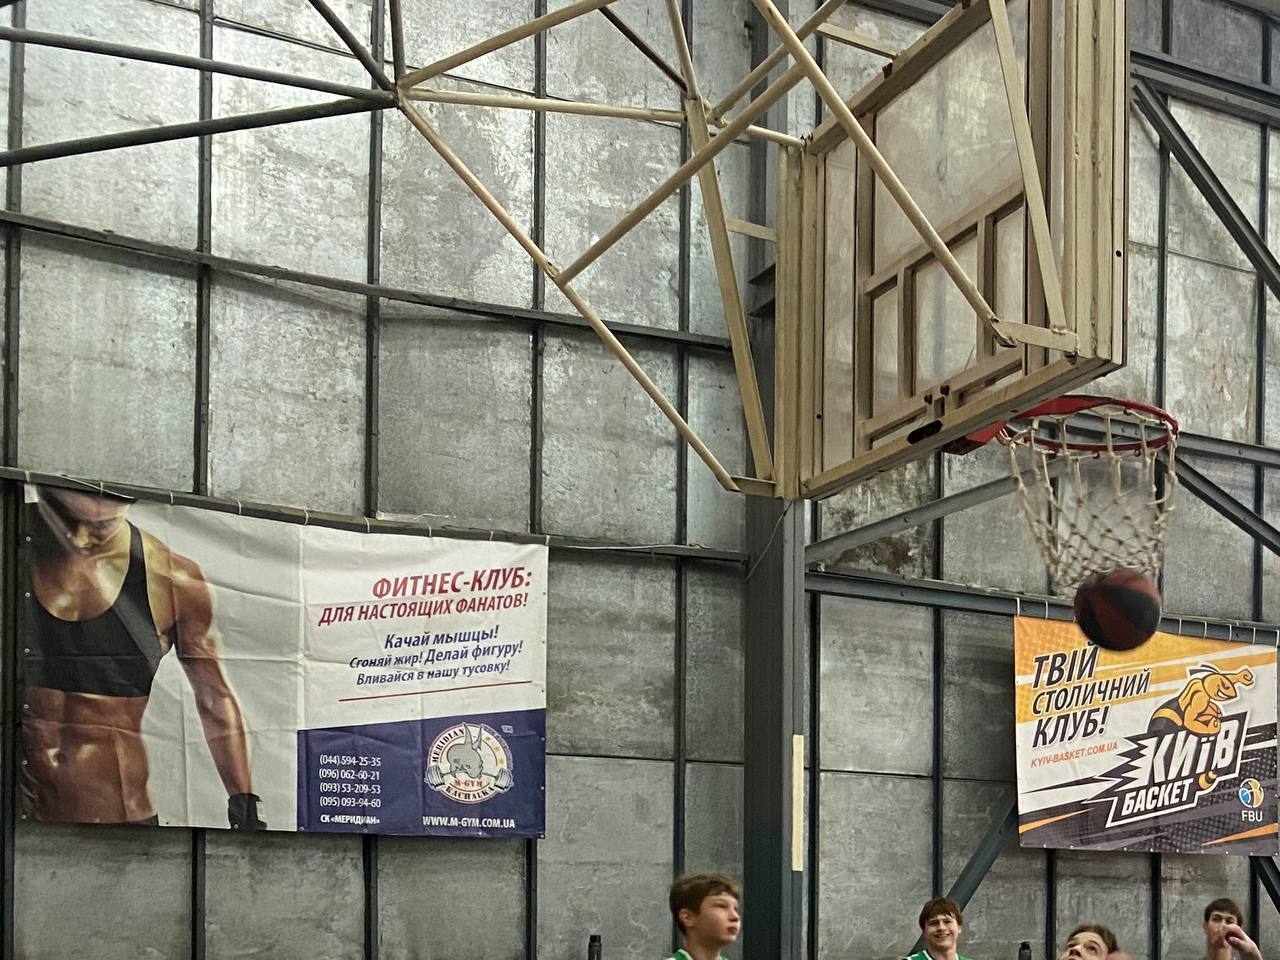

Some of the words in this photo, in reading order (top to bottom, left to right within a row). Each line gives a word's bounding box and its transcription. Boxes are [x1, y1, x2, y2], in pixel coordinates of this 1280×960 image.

[372, 567, 532, 599] ФИТНЕС-КЛУБ:
[318, 606, 355, 626] ДЛЯ
[358, 600, 454, 620] НАСТОЯЩИХ
[456, 593, 529, 614] ФАНАТОВ!
[384, 631, 431, 649] Качай
[433, 625, 500, 645] мышцы!
[349, 655, 392, 668] Сгоняй
[394, 652, 423, 667] жир!
[424, 646, 468, 665] Делай
[472, 640, 523, 660] фигуру!
[1032, 641, 1099, 688] ТВІЙ
[357, 671, 414, 685] Вливайся
[417, 671, 424, 680] в
[427, 667, 459, 679] нашу
[463, 660, 511, 677] тусовку!
[1032, 667, 1151, 714] СТОЛИЧНИЙ
[1032, 706, 1110, 748] КЛУБ!
[432, 728, 465, 763] MERIDIAN
[1030, 742, 1118, 768] KYIV-BASKET.COM.UA
[320, 754, 340, 766] (044)
[341, 755, 381, 766] 594-25-35
[319, 769, 339, 779] (096)
[341, 770, 380, 780] 062-60-21
[320, 783, 340, 793] (093)
[341, 784, 381, 794] 53-209-53
[446, 786, 495, 800] KACHALKA
[1121, 778, 1195, 817] БАСКЕТ
[320, 796, 340, 807] (095)
[341, 797, 381, 808] 093-94-60
[320, 814, 330, 823] СК
[422, 815, 516, 828] WWW.M-GYM.COM.UA
[1241, 810, 1263, 822] FBU
